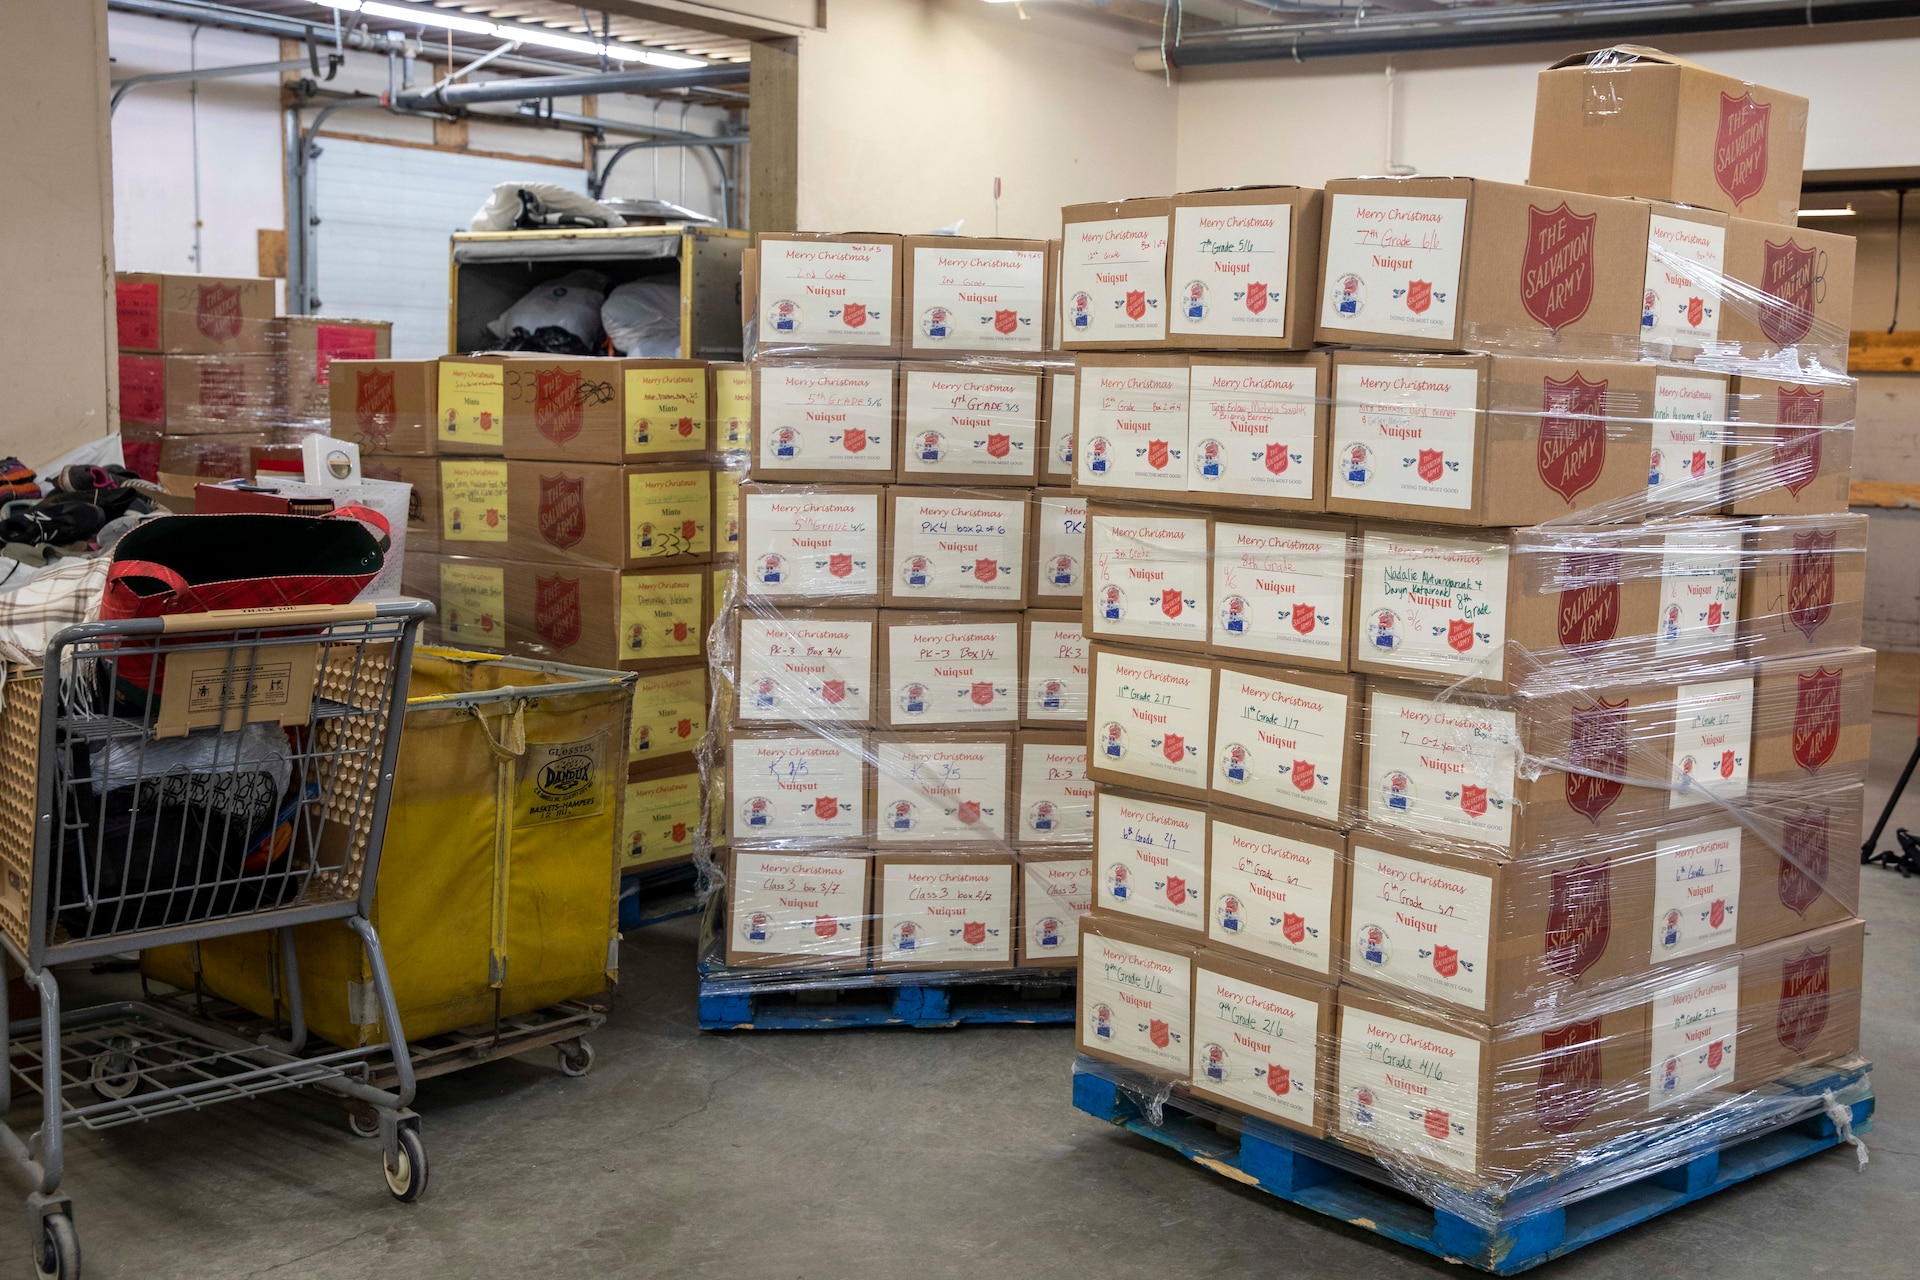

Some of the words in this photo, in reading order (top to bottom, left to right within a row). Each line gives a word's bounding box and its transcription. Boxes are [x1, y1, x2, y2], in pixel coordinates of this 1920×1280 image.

[1727, 105, 1749, 136] THE
[1717, 115, 1766, 173] SALVATION
[1731, 145, 1762, 191] ARMY
[1199, 217, 1224, 231] Merry
[1226, 216, 1275, 228] Christmas
[1356, 207, 1386, 223] Merry
[1388, 208, 1443, 224] Christmas
[1081, 232, 1104, 244] Merry
[1105, 230, 1149, 241] Christmas
[1380, 228, 1411, 248] Grade
[1538, 217, 1568, 256] THE
[786, 250, 816, 262] Merry
[818, 251, 871, 262] Christmas
[938, 257, 968, 269] Merry
[970, 258, 1023, 269] Christmas
[1372, 255, 1414, 272] Nuiqsut
[1525, 225, 1589, 299] SALVATION
[1214, 261, 1251, 276] Nuiqsut
[1096, 272, 1129, 286] Nuiqsut
[806, 285, 846, 298] Nuiqsut
[958, 292, 998, 305] Nuiqsut
[1545, 262, 1585, 318] ARMY
[543, 375, 562, 399] THE
[785, 376, 815, 388] Merry
[817, 377, 871, 387] Christmas
[932, 381, 961, 392] Merry
[963, 382, 1016, 393] Christmas
[1101, 378, 1126, 391] Merry
[1127, 378, 1173, 389] Christmas
[1212, 376, 1241, 390] Merry
[1242, 377, 1295, 390] Christmas
[1360, 376, 1392, 392] Merry
[1393, 378, 1452, 393] Christmas
[538, 378, 577, 426] SALVATION
[659, 405, 678, 413] Minto
[553, 408, 577, 436] ARMY
[806, 411, 846, 423] Nuiqsut
[951, 416, 991, 428] Nuiqsut
[1116, 419, 1151, 433] Nuiqsut
[1230, 421, 1269, 436] Nuiqsut
[1379, 424, 1423, 441] Nuiqsut
[1542, 393, 1601, 469] SALVATION
[1560, 429, 1598, 487] ARMY
[546, 481, 564, 505] THE
[541, 485, 581, 530] SALVATION
[661, 508, 681, 516] Minto
[771, 503, 801, 514] Merry
[803, 504, 857, 512] Christmas
[919, 506, 949, 517] Merry
[951, 507, 1004, 518] Christmas
[555, 508, 579, 541] ARMY
[921, 521, 948, 533] PK4
[956, 523, 974, 533] box
[975, 524, 984, 534] 2
[997, 525, 1006, 535] 6
[1112, 526, 1137, 539] Merry
[1139, 527, 1186, 540] Christmas
[650, 533, 699, 558] 332
[792, 537, 832, 549] Nuiqsut
[938, 541, 979, 553] Nuiqsut
[1237, 533, 1266, 549] Merry
[1268, 536, 1322, 552] Christmas
[1129, 567, 1164, 582] Nuiqsut
[1256, 578, 1296, 594] Nuiqsut
[275, 605, 298, 613] YOU
[1408, 592, 1453, 610] Nuiqsut
[653, 610, 673, 618] Minto
[1464, 603, 1492, 619] Grade
[797, 629, 850, 640] Christmas
[913, 634, 942, 644] Merry
[945, 634, 997, 643] Christmas
[806, 647, 824, 656] Box
[959, 647, 978, 659] Box
[785, 663, 826, 674] Nuiqsut
[934, 667, 974, 679] Nuiqsut
[1116, 664, 1142, 680] Merry
[1143, 670, 1191, 686] Christmas
[1131, 689, 1151, 702] Grade
[1241, 684, 1270, 701] Merry
[1271, 691, 1324, 712] Christmas
[1804, 679, 1823, 713] THE
[1132, 707, 1167, 724] Nuiqsut
[1256, 710, 1279, 725] Grade
[1400, 707, 1431, 724] Merry
[1795, 681, 1838, 751] SALVATION
[1258, 730, 1297, 750] Nuiqsut
[1807, 718, 1834, 763] ARMY
[757, 748, 787, 757] Merry
[789, 748, 841, 757] Christmas
[1420, 755, 1466, 774] Nuiqsut
[544, 762, 591, 788] DANDUX
[777, 782, 818, 792] Nuiqsut
[1120, 806, 1144, 822] Merry
[1146, 812, 1190, 830] Christmas
[1135, 828, 1153, 845] Grade
[1136, 849, 1169, 867] Nuiqsut
[1232, 835, 1260, 854] Merry
[1261, 844, 1312, 865] Christmas
[760, 863, 790, 874] Merry
[792, 864, 844, 876] Christmas
[1254, 863, 1274, 881] Grade
[763, 878, 785, 891] Class
[788, 878, 796, 891] 3
[803, 882, 816, 892] box
[908, 873, 937, 884] Merry
[939, 873, 990, 882] Christmas
[1377, 862, 1408, 881] Merry
[1409, 871, 1467, 895] Christmas
[909, 888, 939, 901] Class
[940, 887, 949, 898] 3
[957, 890, 973, 899] box
[1249, 882, 1287, 902] Nuiqsut
[1400, 888, 1424, 910] Grade
[779, 897, 819, 909] Nuiqsut
[927, 906, 967, 918] Nuiqsut
[1395, 911, 1438, 934] Nuiqsut
[1103, 947, 1127, 964] Merry
[1128, 955, 1174, 974] Christmas
[1117, 966, 1141, 987] Grade
[1119, 991, 1153, 1009] Nuiqsut
[1216, 985, 1244, 1005] Merry
[1245, 995, 1296, 1019] Christmas
[1231, 1007, 1257, 1030] Grade
[1234, 1032, 1272, 1054] Nuiqsut
[1367, 1023, 1398, 1044] Merry
[1399, 1033, 1456, 1057] Christmas
[1382, 1048, 1413, 1069] Grade
[1385, 1073, 1429, 1096] Nuiqsut
